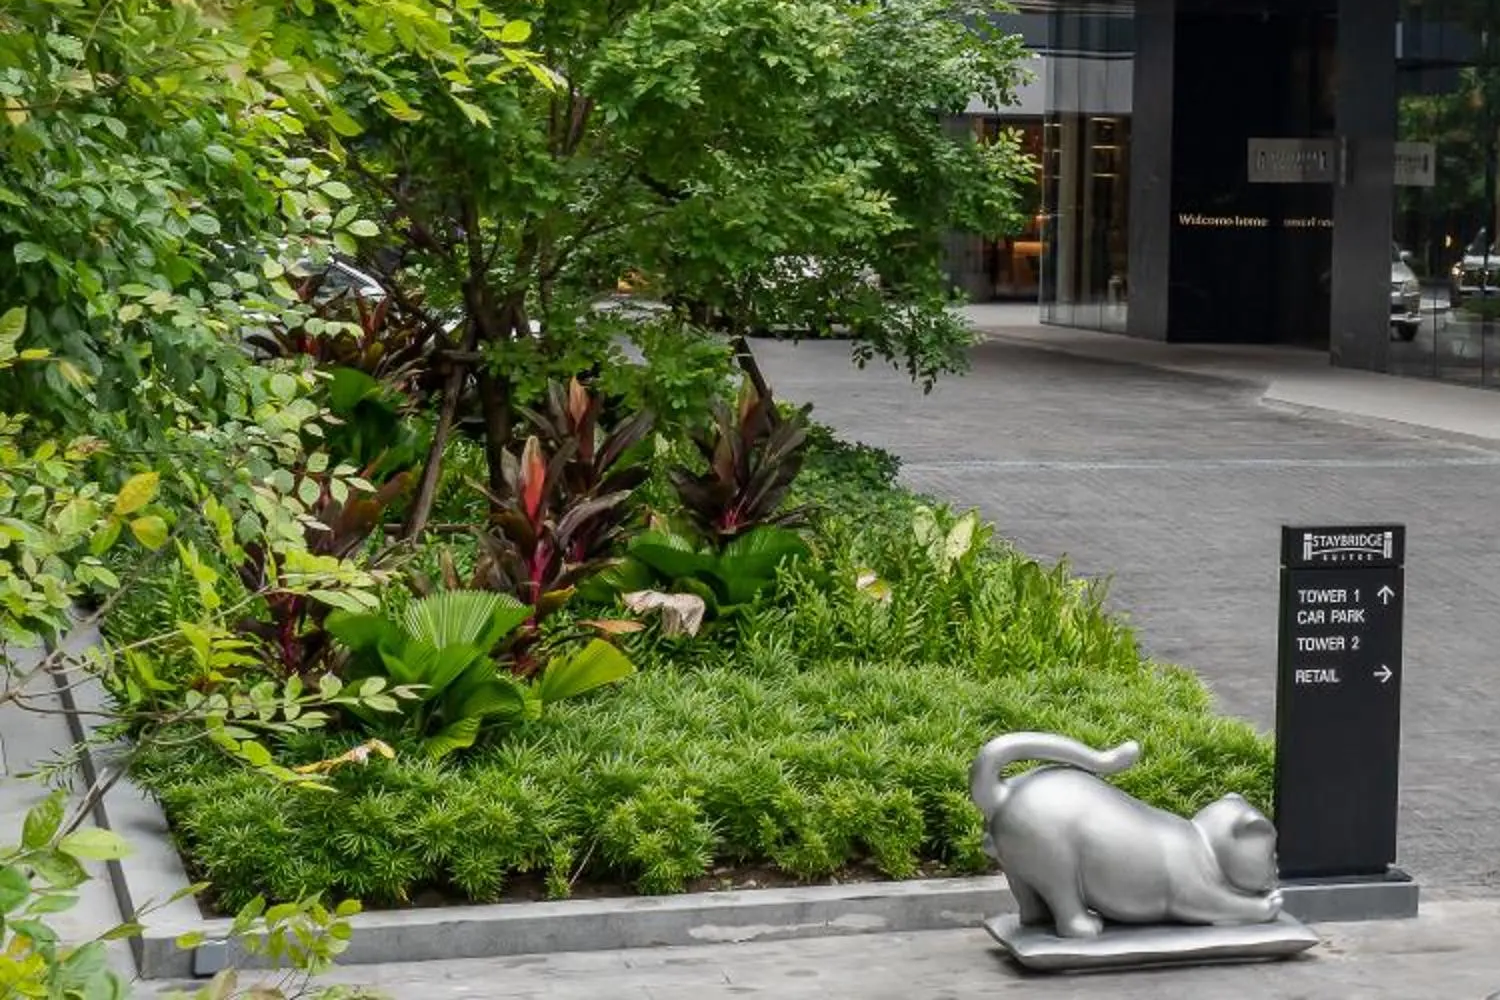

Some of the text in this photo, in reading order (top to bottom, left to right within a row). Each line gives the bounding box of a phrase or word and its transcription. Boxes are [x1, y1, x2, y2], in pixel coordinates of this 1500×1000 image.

[1312, 533, 1384, 547] STAYBRIDGE
[1298, 589, 1360, 602] TOWER 1
[1297, 609, 1365, 624] CAR PARK
[1296, 636, 1360, 651] TOWER 2
[1295, 669, 1340, 684] RETAIL
